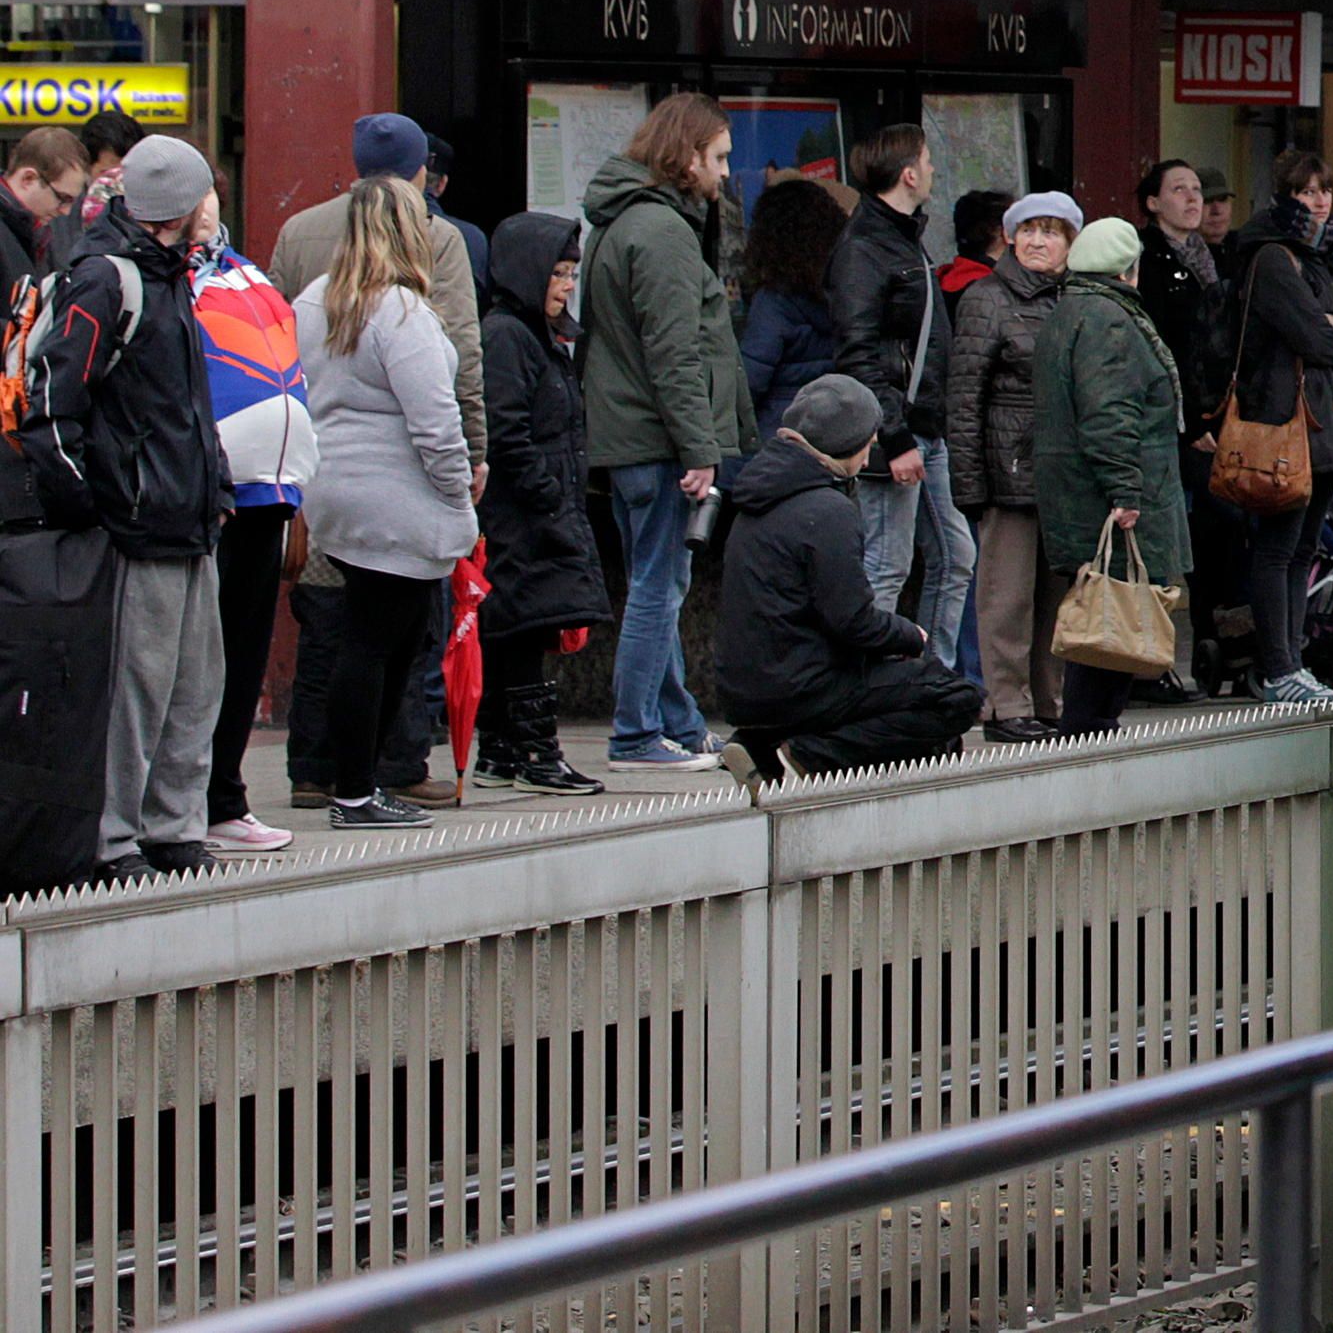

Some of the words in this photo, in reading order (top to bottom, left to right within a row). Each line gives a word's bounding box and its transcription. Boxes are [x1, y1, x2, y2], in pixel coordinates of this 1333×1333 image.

[766, 2, 912, 47] INFORMATION
[987, 13, 1027, 54] KVB
[1182, 33, 1294, 83] KIOSK
